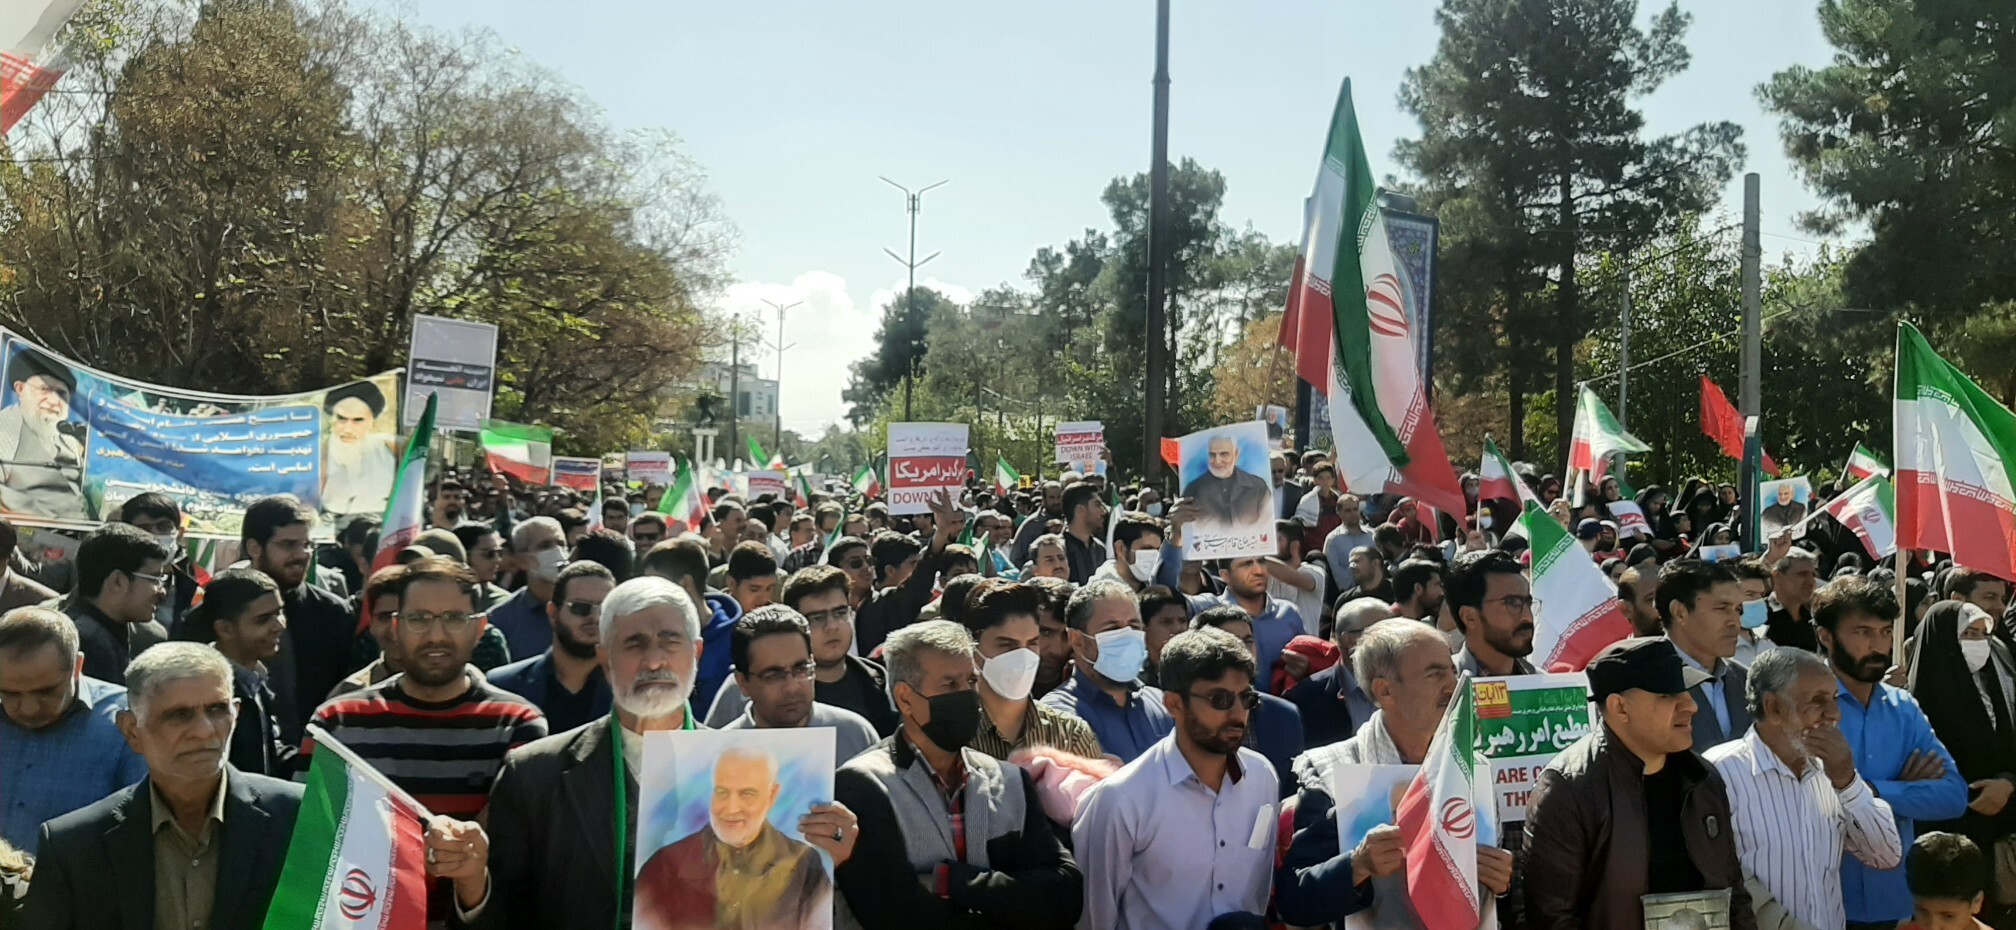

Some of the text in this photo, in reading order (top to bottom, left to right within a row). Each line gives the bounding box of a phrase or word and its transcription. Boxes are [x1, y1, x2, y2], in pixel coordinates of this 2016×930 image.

[203, 430, 253, 443] اسلامی
[256, 428, 313, 441] جمهوری
[892, 491, 933, 505] DOWN
[1551, 713, 1591, 750] مطیع
[1496, 766, 1528, 784] ARE
